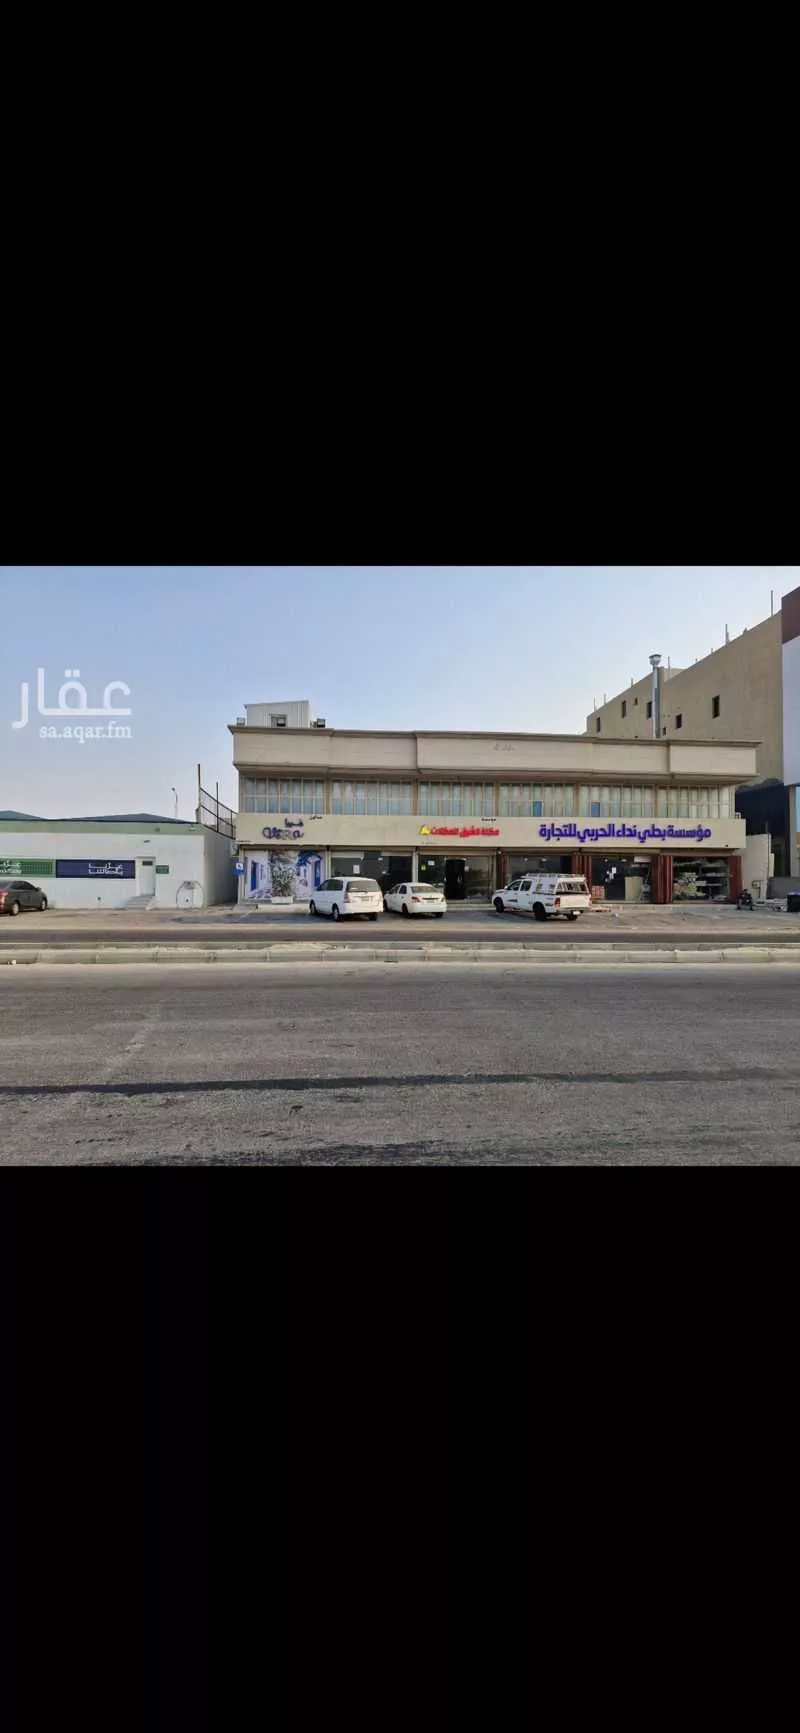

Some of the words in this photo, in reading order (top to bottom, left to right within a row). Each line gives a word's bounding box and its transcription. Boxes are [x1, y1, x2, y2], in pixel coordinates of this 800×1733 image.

[539, 823, 576, 841] للتجارة
[577, 823, 615, 842] الحربي
[616, 823, 637, 838] نداء
[638, 823, 666, 843] بطي
[667, 824, 712, 842] مؤسسة
